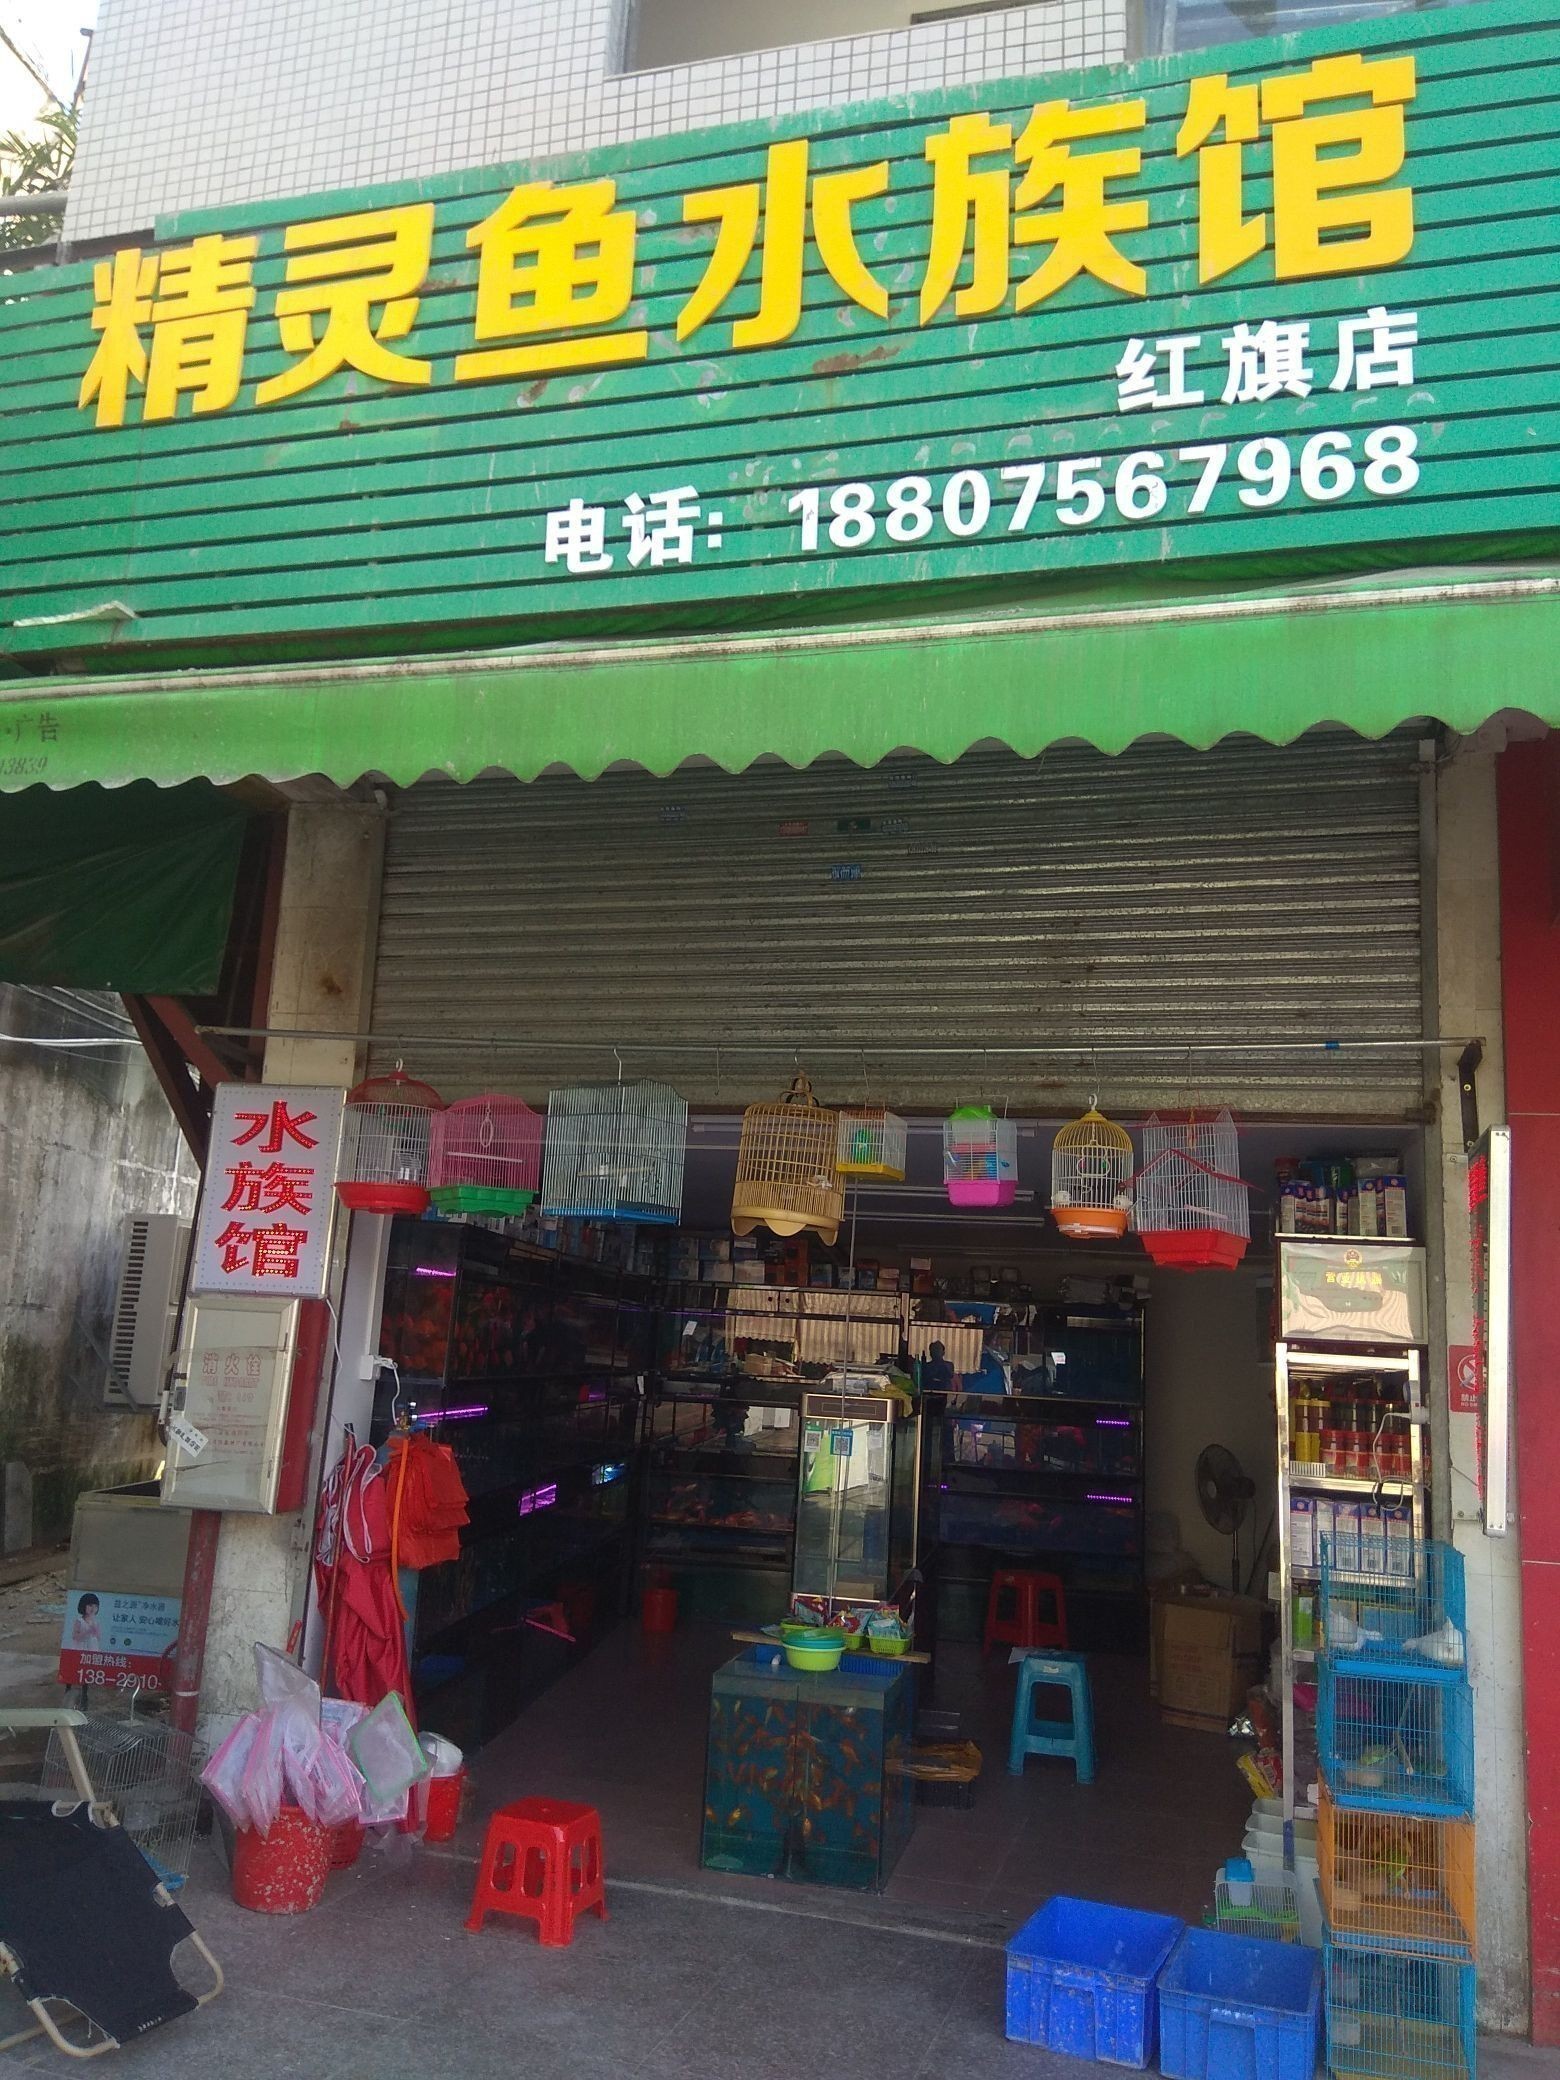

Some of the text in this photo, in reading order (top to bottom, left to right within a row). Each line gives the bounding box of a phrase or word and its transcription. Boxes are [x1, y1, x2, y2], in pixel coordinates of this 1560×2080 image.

[77, 53, 1418, 428] 精灵鱼水族馆
[1114, 305, 1420, 414] 红旗店
[544, 426, 1421, 574] 电话: 18807567968
[214, 1099, 320, 1279] 水族馆
[202, 1352, 263, 1377] 消火栓
[79, 1652, 132, 1669] 加盟热线:
